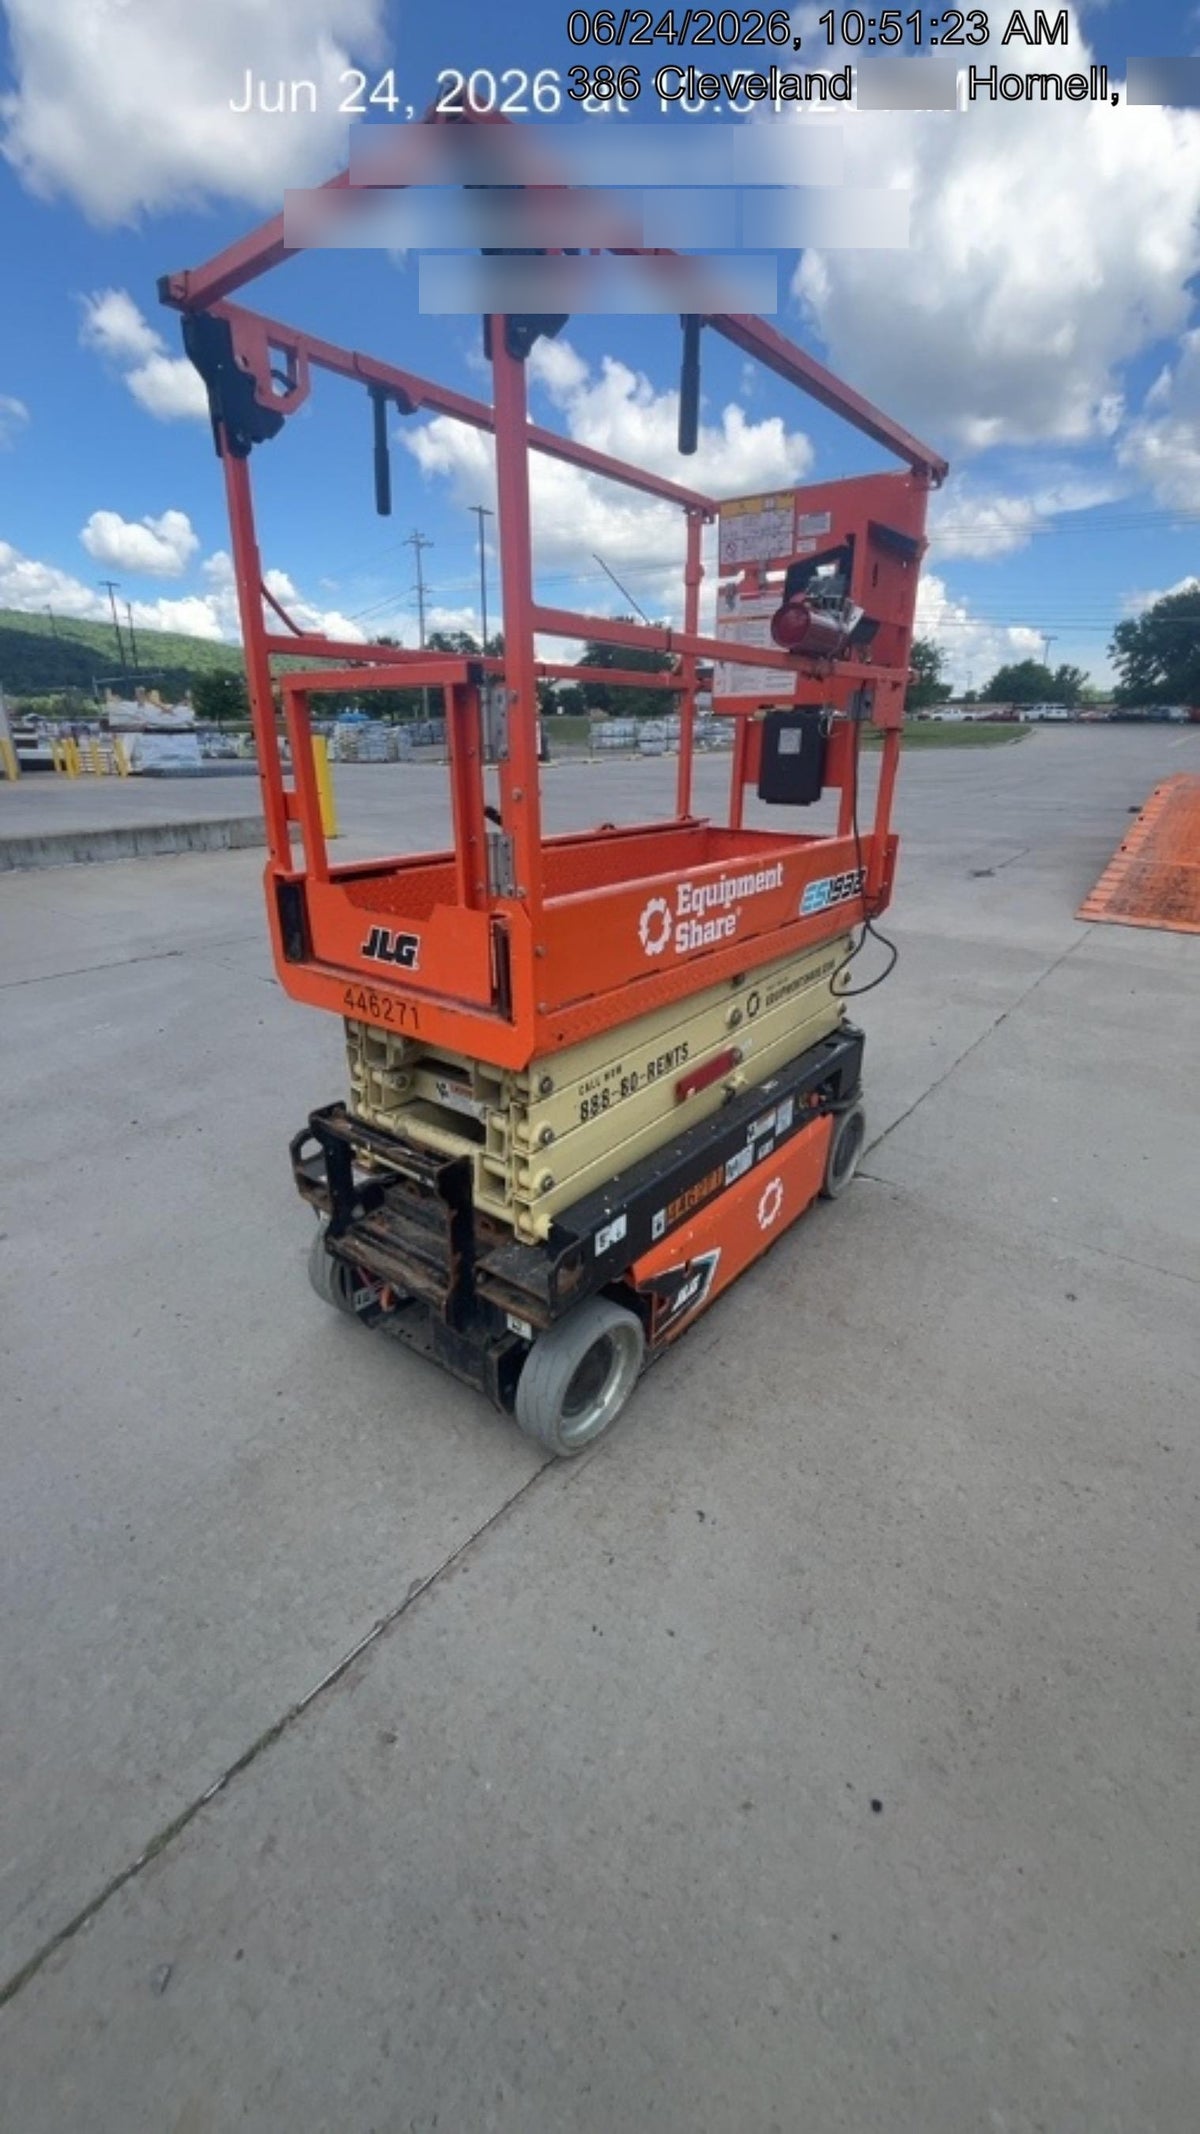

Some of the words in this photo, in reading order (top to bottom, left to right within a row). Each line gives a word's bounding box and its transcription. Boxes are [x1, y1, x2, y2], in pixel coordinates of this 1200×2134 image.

[676, 862, 783, 916] Equipment
[361, 926, 420, 971] JLG
[675, 913, 736, 954] Share
[343, 988, 419, 1030] 446271
